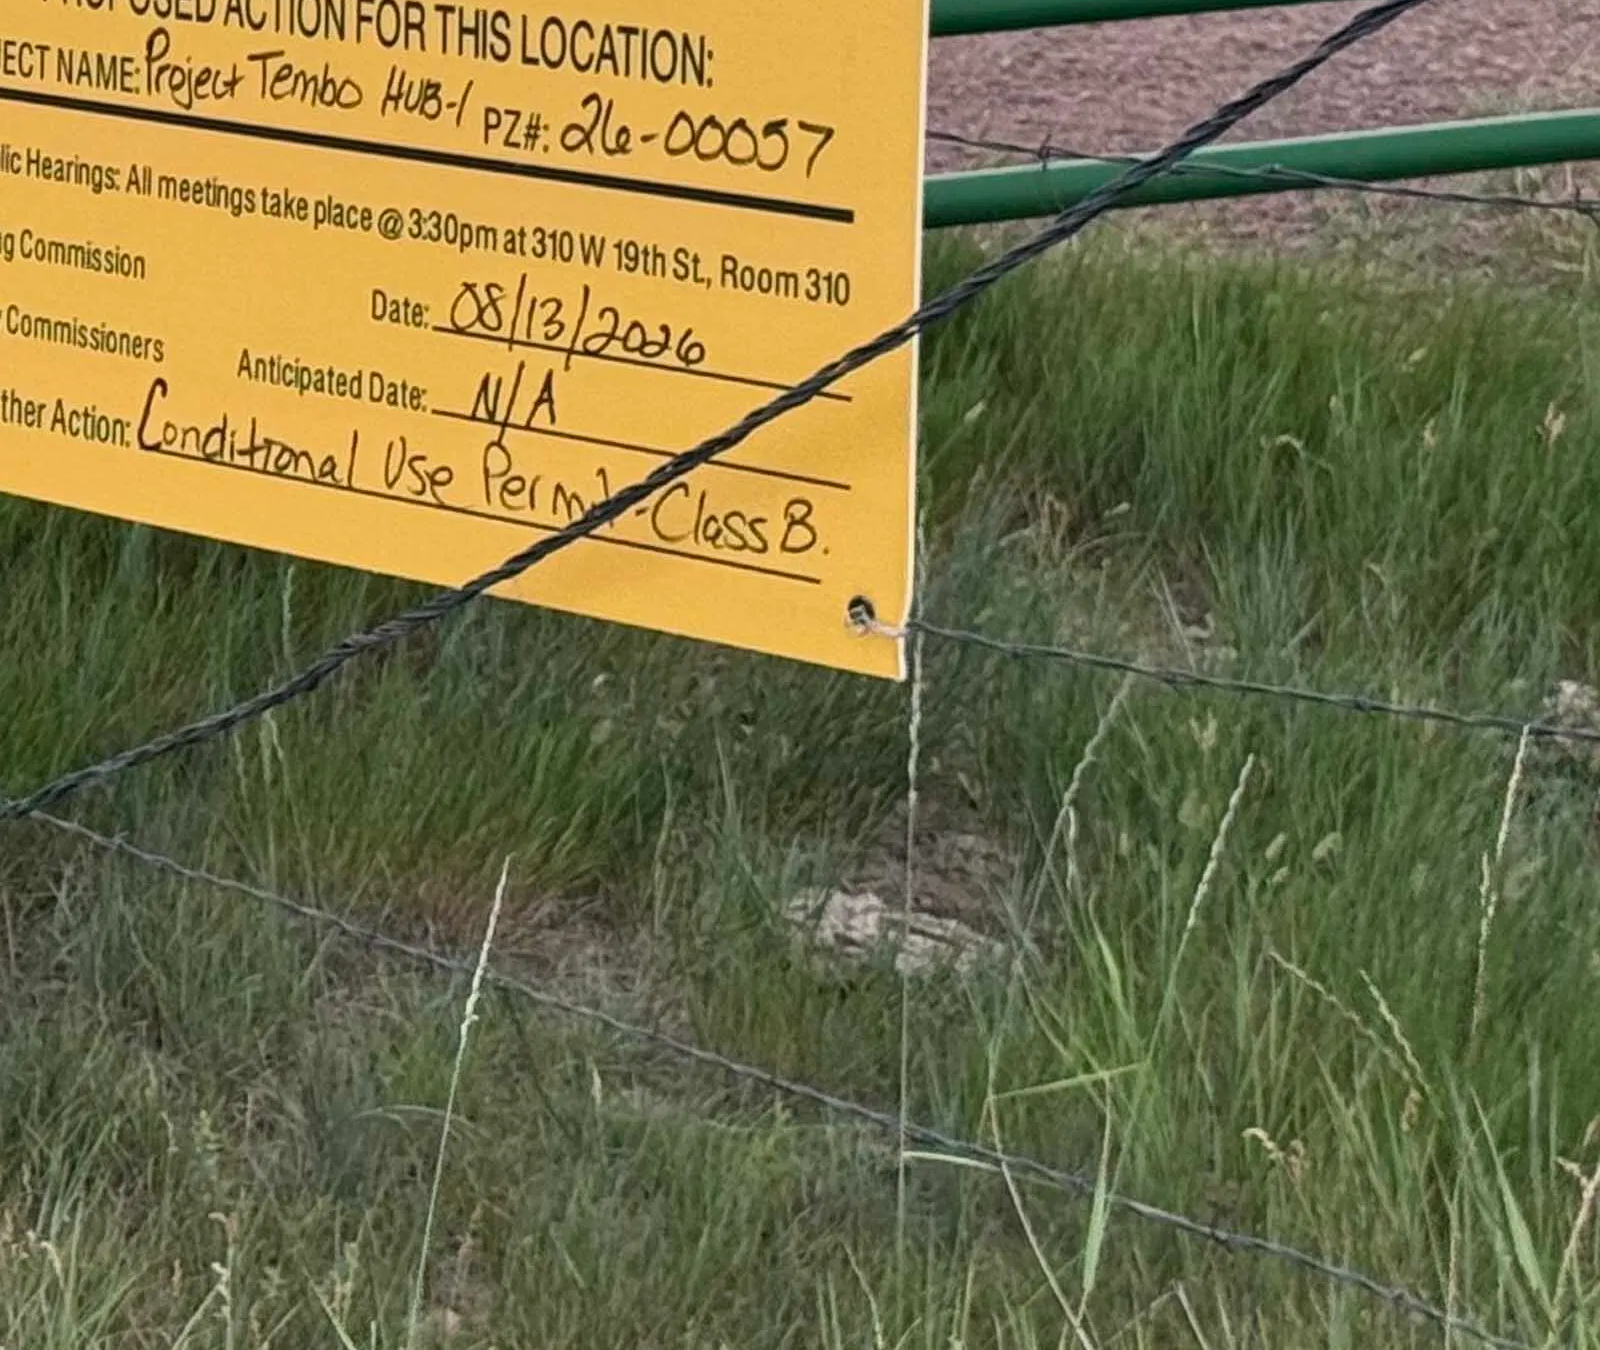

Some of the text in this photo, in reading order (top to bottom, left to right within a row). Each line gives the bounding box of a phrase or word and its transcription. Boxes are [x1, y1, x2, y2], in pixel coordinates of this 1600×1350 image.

[434, 3, 512, 63] THIS
[521, 13, 716, 89] LOCATION:
[55, 47, 141, 96] NAME:
[144, 26, 246, 111] Project
[246, 50, 363, 110] Tembo
[483, 106, 550, 154] PZ#:
[559, 91, 836, 179] 26-00057
[18, 228, 148, 281] Commission
[25, 147, 122, 195] Hearings:
[125, 163, 153, 198] All
[157, 173, 257, 218] meetings
[261, 187, 309, 222] take
[312, 195, 373, 231] place
[377, 207, 405, 240] @
[407, 206, 499, 254] 3:30pm
[503, 226, 528, 257] at
[531, 229, 574, 264] 310
[579, 233, 606, 268] W
[612, 240, 667, 280] 19th
[720, 254, 799, 299] Room
[805, 268, 852, 307] 310
[5, 304, 166, 364] Commissioners
[371, 272, 707, 372] Date: 08/13/2026
[238, 348, 558, 440] Anticipated Date: N/A
[49, 398, 131, 449] Action:
[136, 377, 360, 489] Conditional
[384, 435, 455, 496] Use
[779, 497, 831, 556] B.
